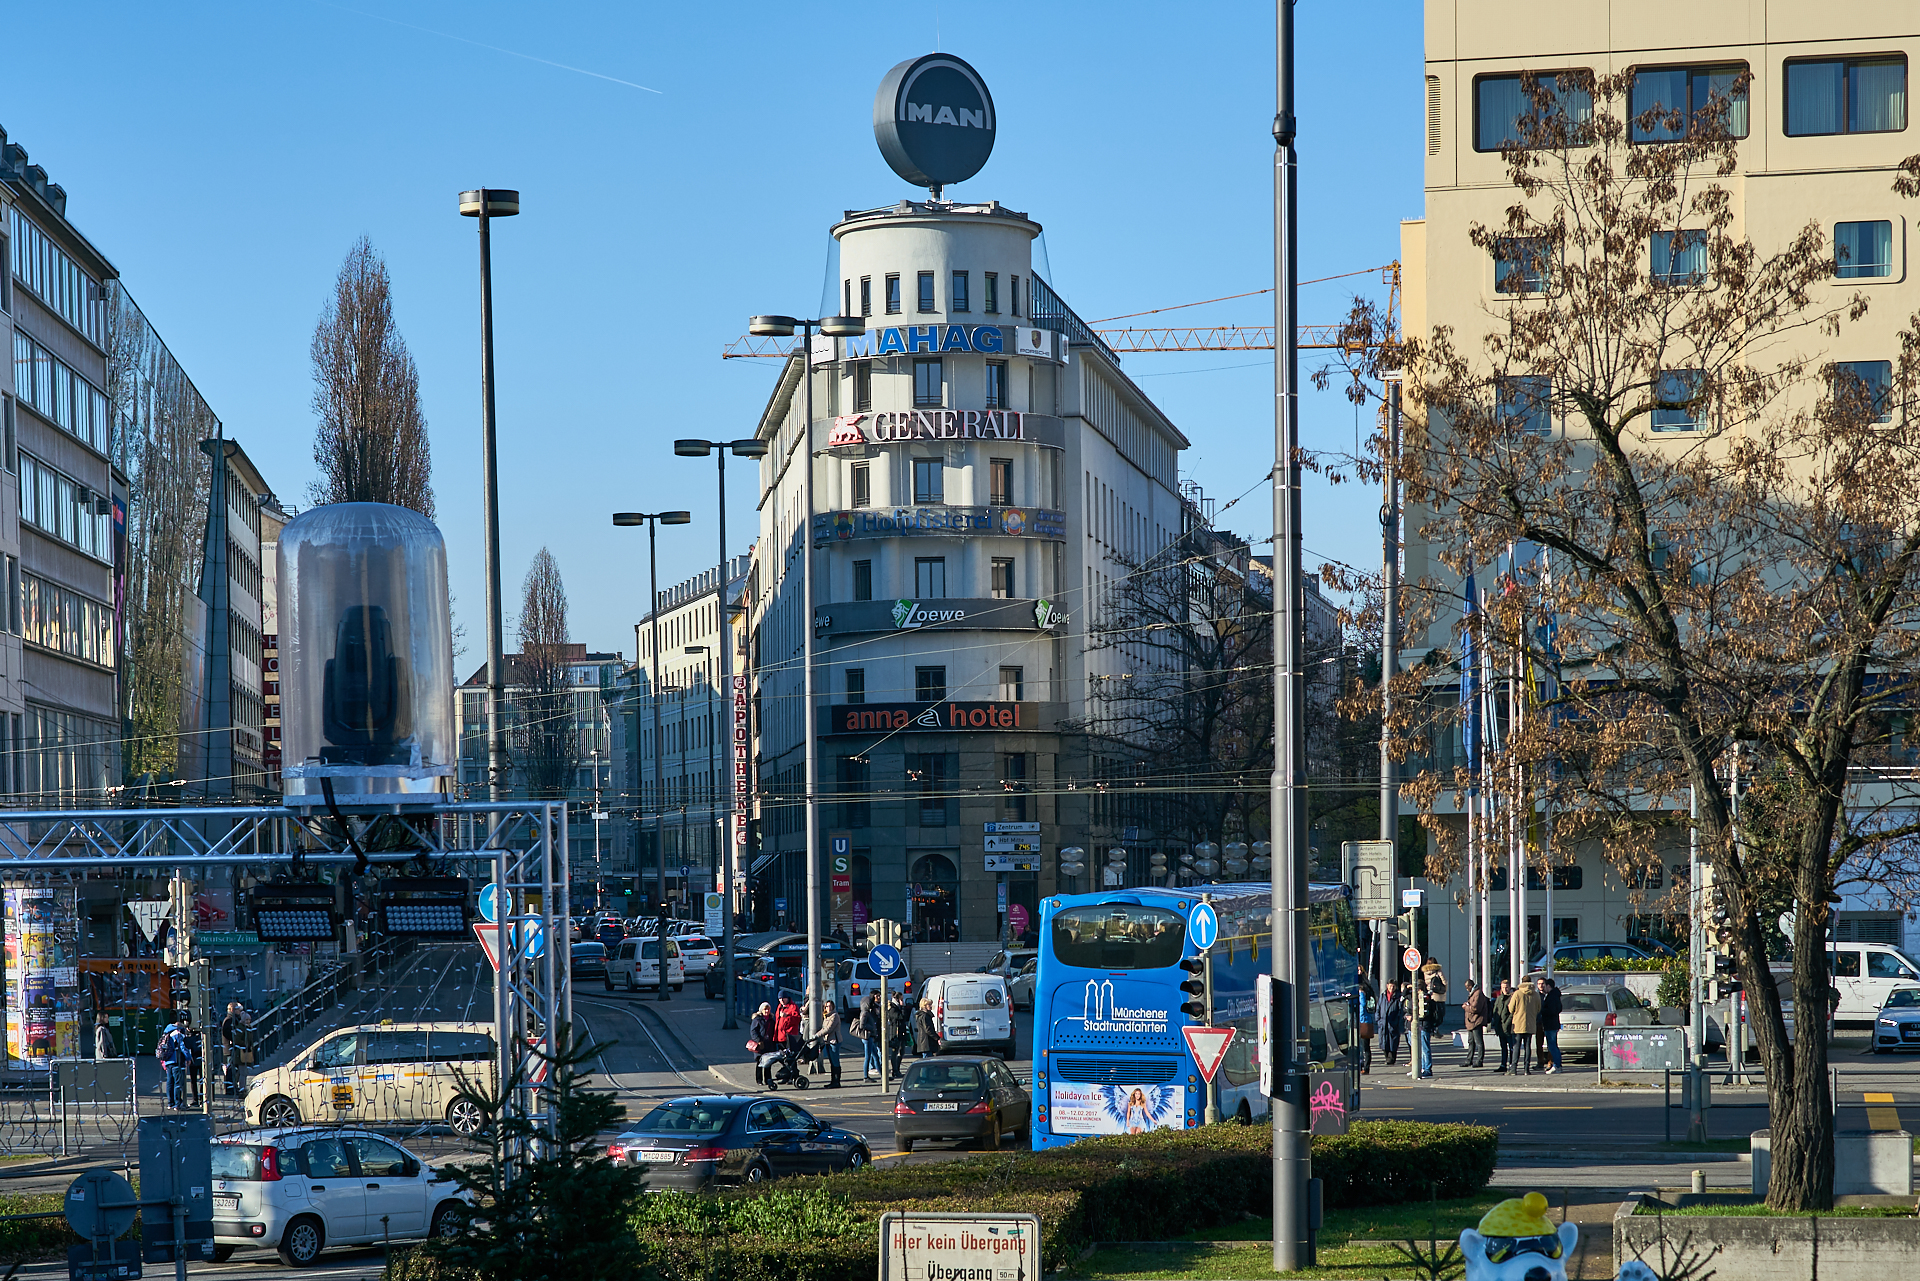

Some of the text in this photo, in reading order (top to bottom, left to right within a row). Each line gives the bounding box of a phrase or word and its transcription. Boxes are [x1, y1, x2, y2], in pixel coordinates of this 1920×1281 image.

[908, 102, 984, 129] MAN
[846, 325, 1004, 358] MAHAG
[1020, 348, 1050, 356] PORSCHE
[872, 410, 1026, 441] GENERALI
[862, 508, 993, 535] Hofpfisterei
[902, 603, 964, 628] Loewe
[1042, 604, 1070, 629] Loewe
[846, 704, 1020, 730] anna hotel
[836, 839, 846, 853] U
[835, 857, 847, 872] S
[1114, 1007, 1167, 1019] Münchener
[1084, 1020, 1167, 1033] Stadtrundfahrten
[1055, 1090, 1082, 1101] Holiday
[1091, 1092, 1102, 1101] Ice
[894, 1230, 1026, 1254] Hier kein Übergang
[927, 1260, 992, 1281] Übergang
